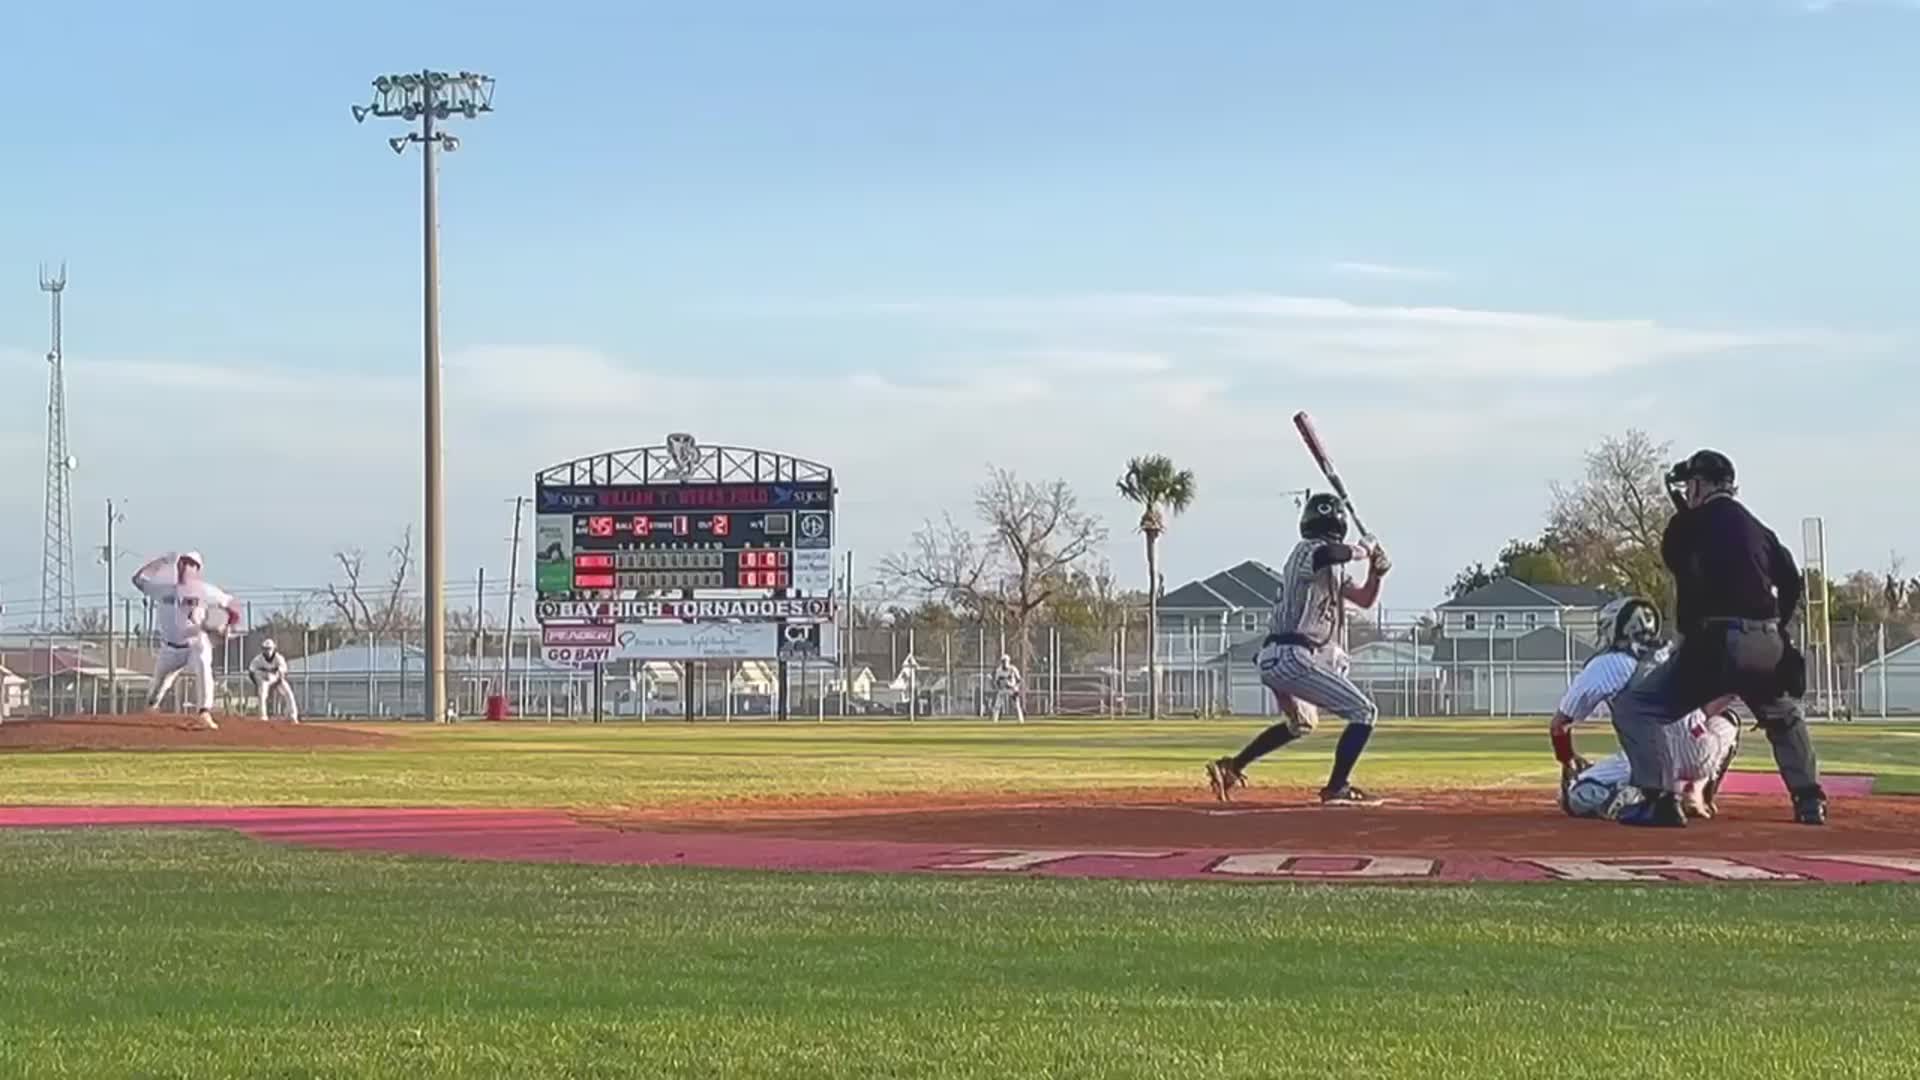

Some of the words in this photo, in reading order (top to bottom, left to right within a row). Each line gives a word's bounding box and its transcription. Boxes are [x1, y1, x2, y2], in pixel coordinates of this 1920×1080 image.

[633, 516, 649, 536] 2
[712, 515, 728, 535] 2
[560, 602, 600, 617] BAY
[608, 601, 662, 617] HIGH
[669, 600, 803, 617] TORNADOES
[548, 648, 572, 660] GO
[575, 648, 610, 660] BAY!
[915, 848, 1920, 882] TOR
